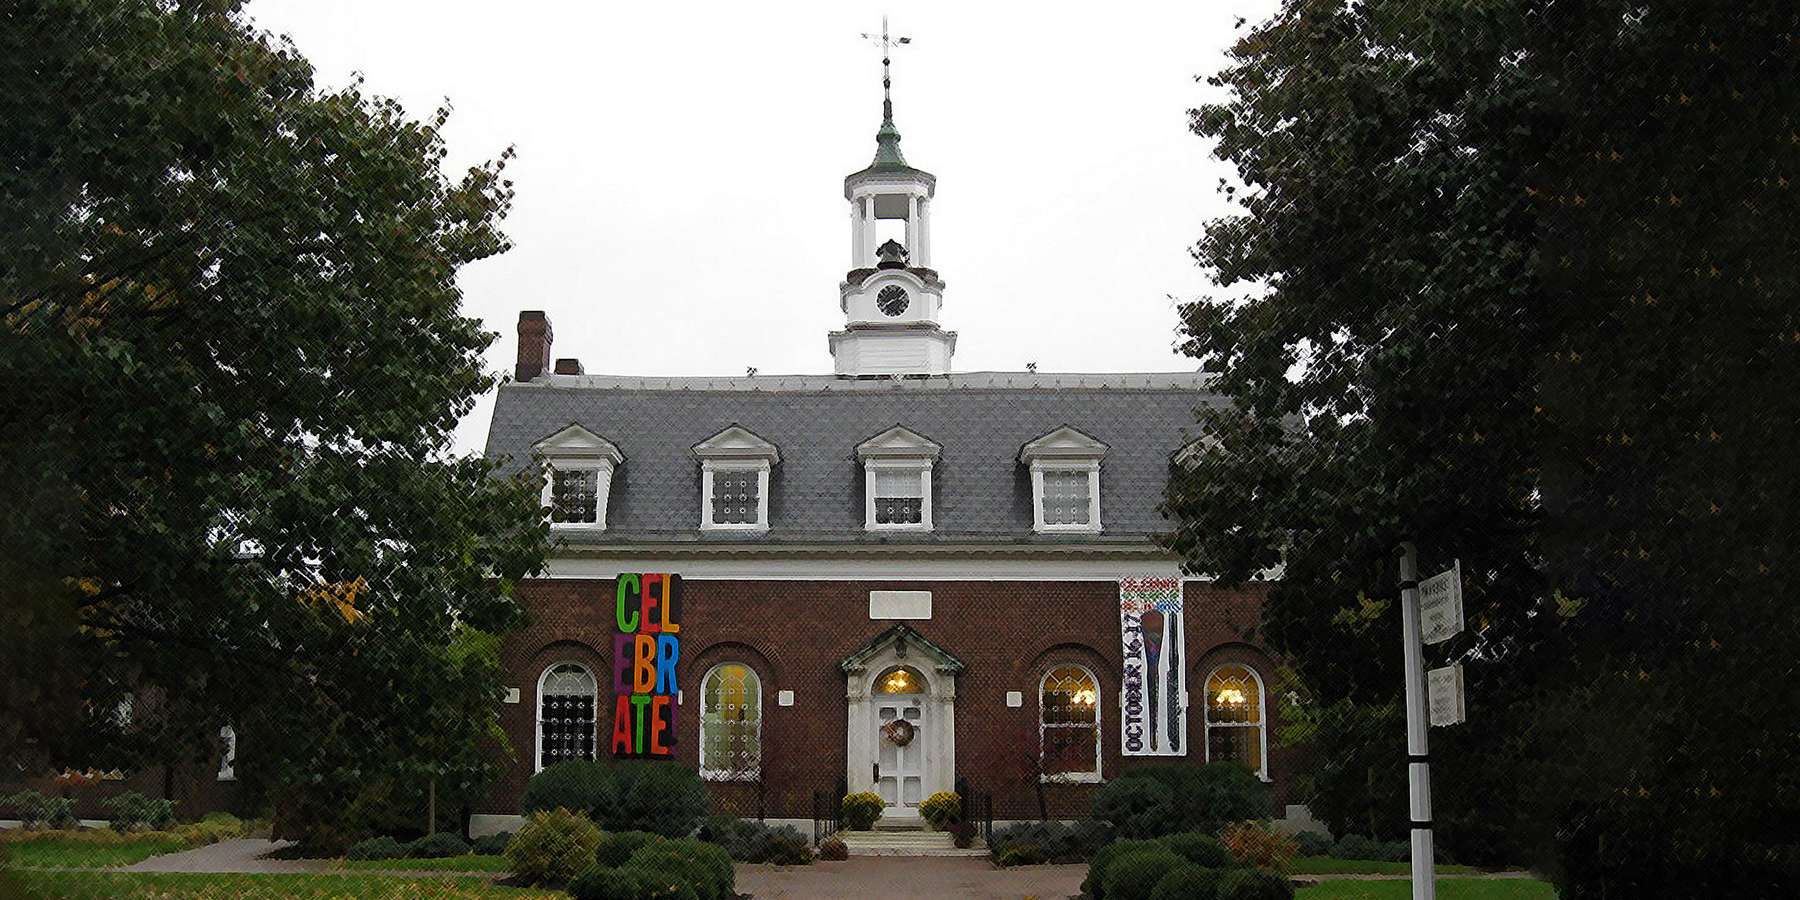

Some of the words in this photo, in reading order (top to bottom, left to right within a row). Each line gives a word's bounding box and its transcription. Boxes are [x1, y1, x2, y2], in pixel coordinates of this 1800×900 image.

[616, 573, 680, 633] CEL
[613, 633, 679, 694] EBR
[1124, 664, 1143, 752] OCTOBER
